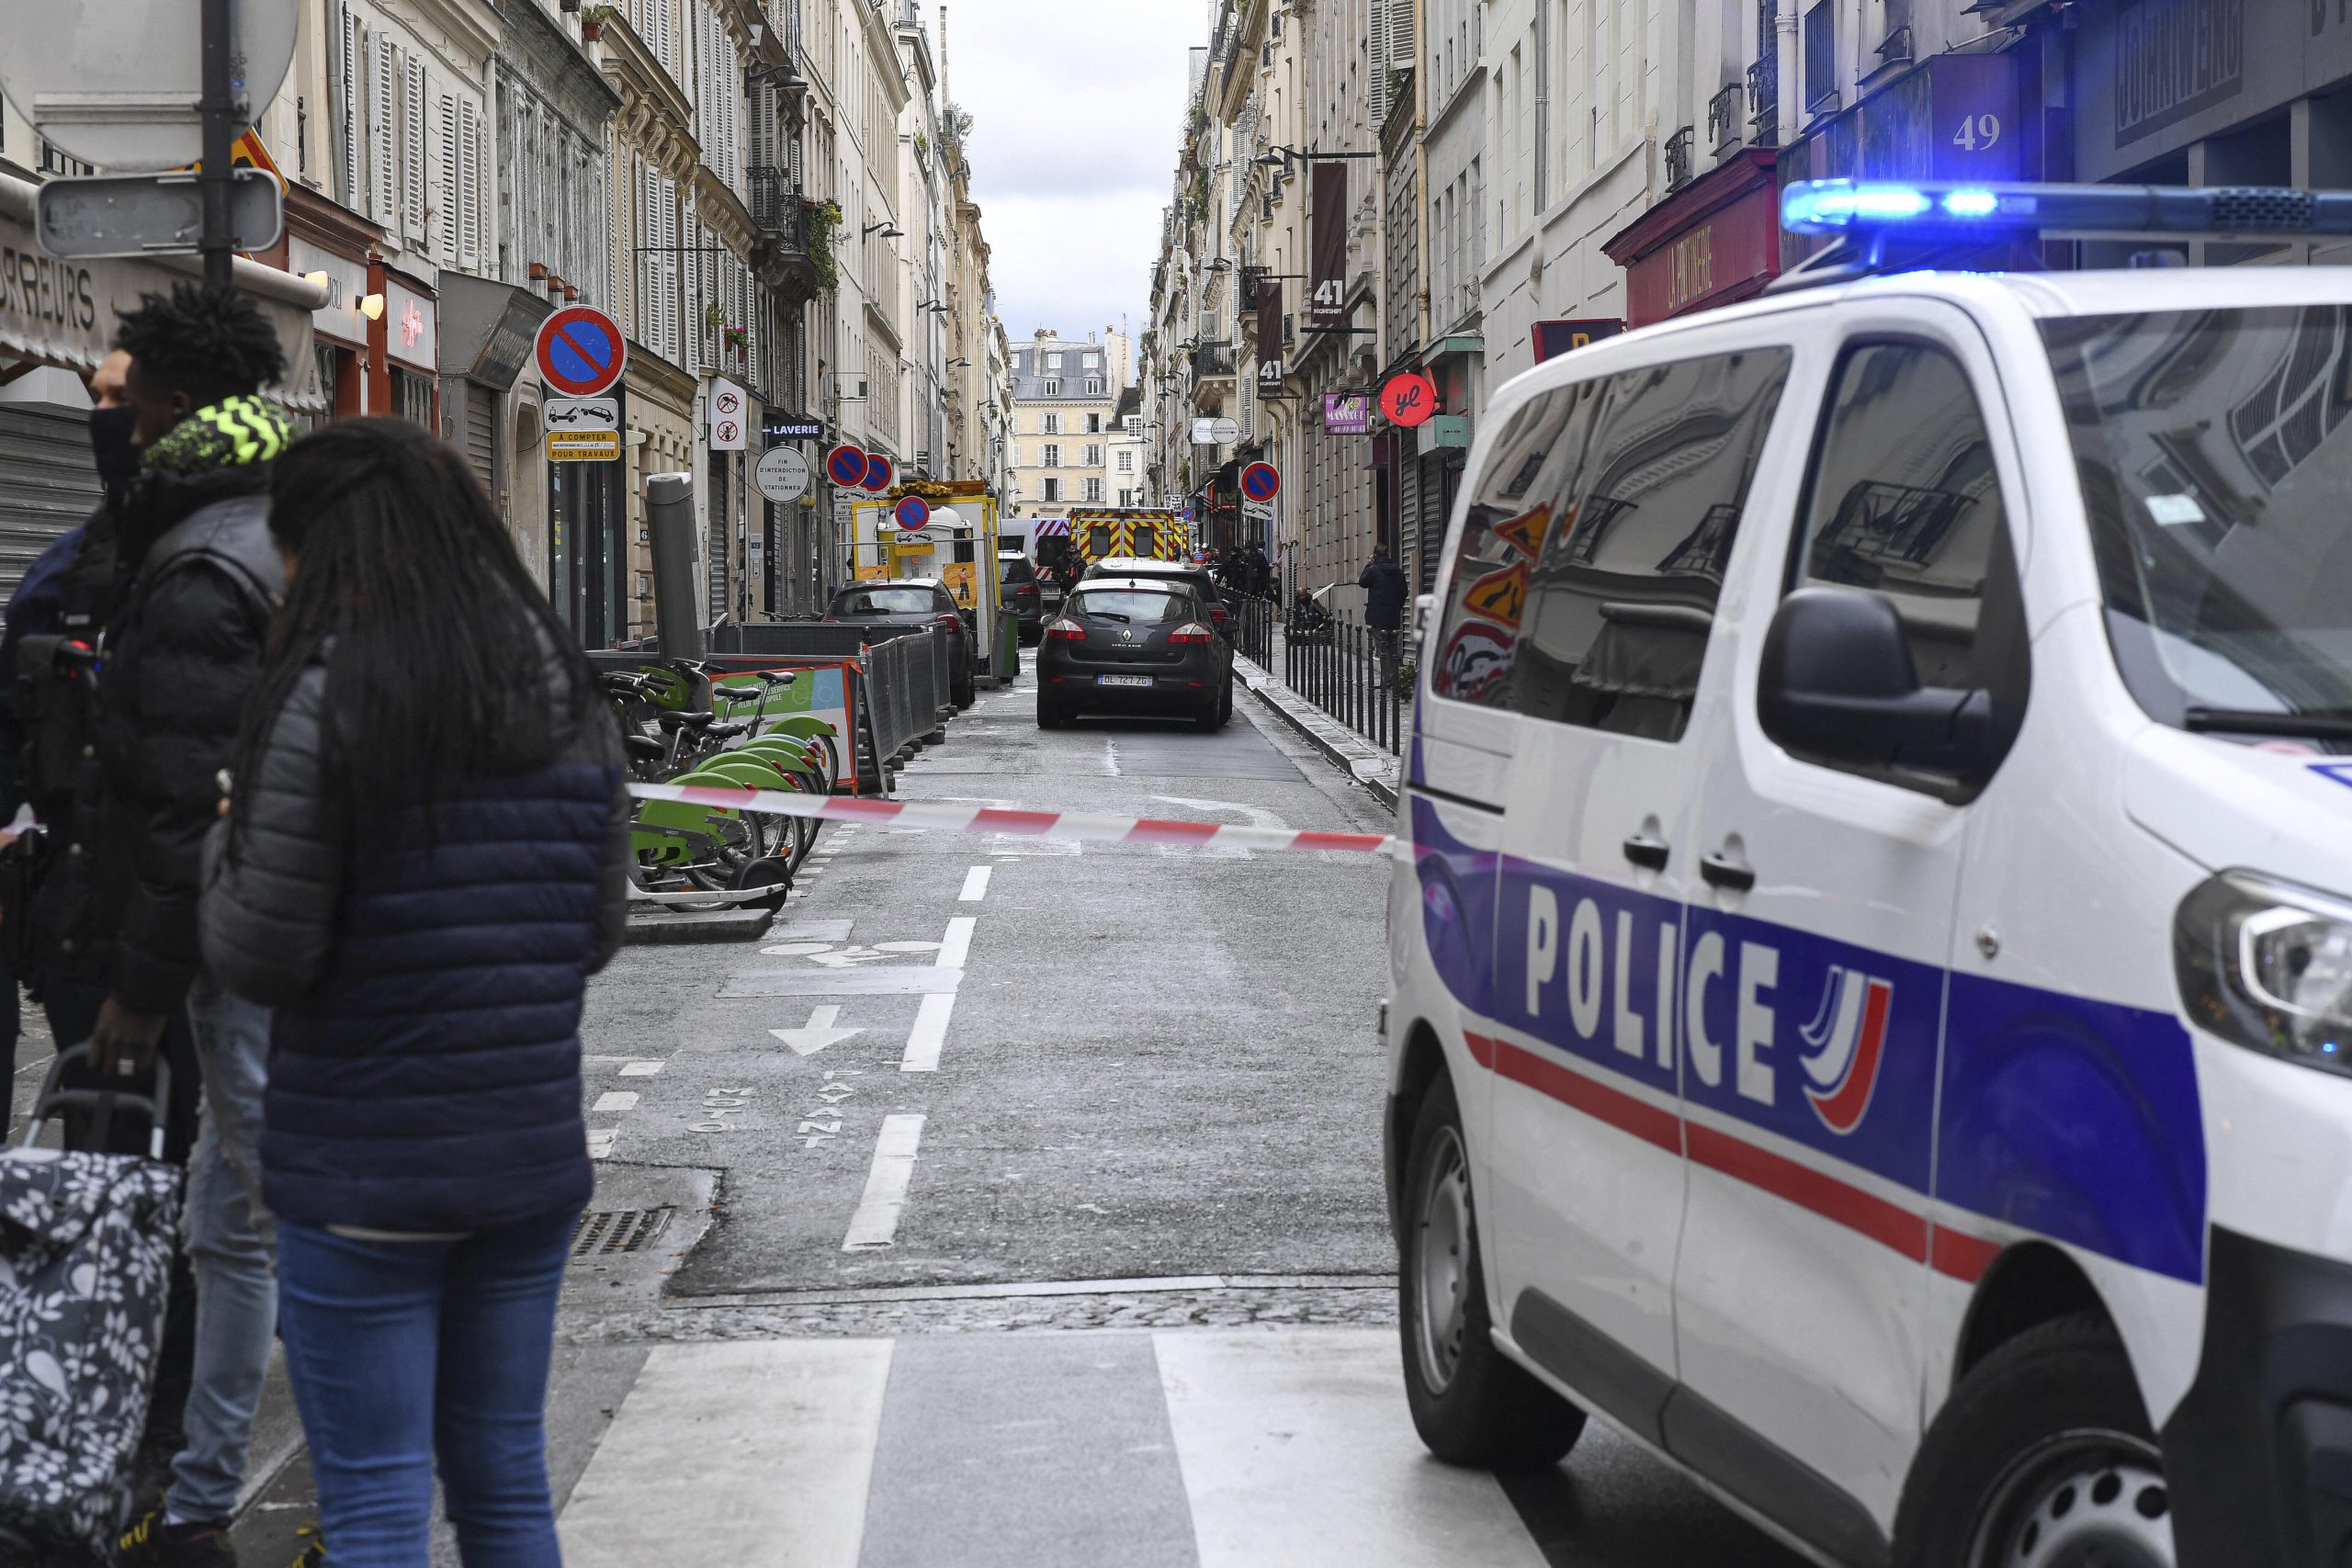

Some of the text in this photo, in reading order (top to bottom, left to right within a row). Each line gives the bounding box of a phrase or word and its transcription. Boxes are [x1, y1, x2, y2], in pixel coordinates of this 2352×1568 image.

[1952, 114, 2000, 152] 49
[1314, 279, 1343, 306] 41
[1668, 246, 1676, 310] LA
[1259, 360, 1282, 379] 41
[774, 425, 819, 434] LAVERIE
[1525, 883, 1780, 1108] POLICE
[686, 1088, 752, 1134] MOTO
[792, 1070, 864, 1148] PAYANT
